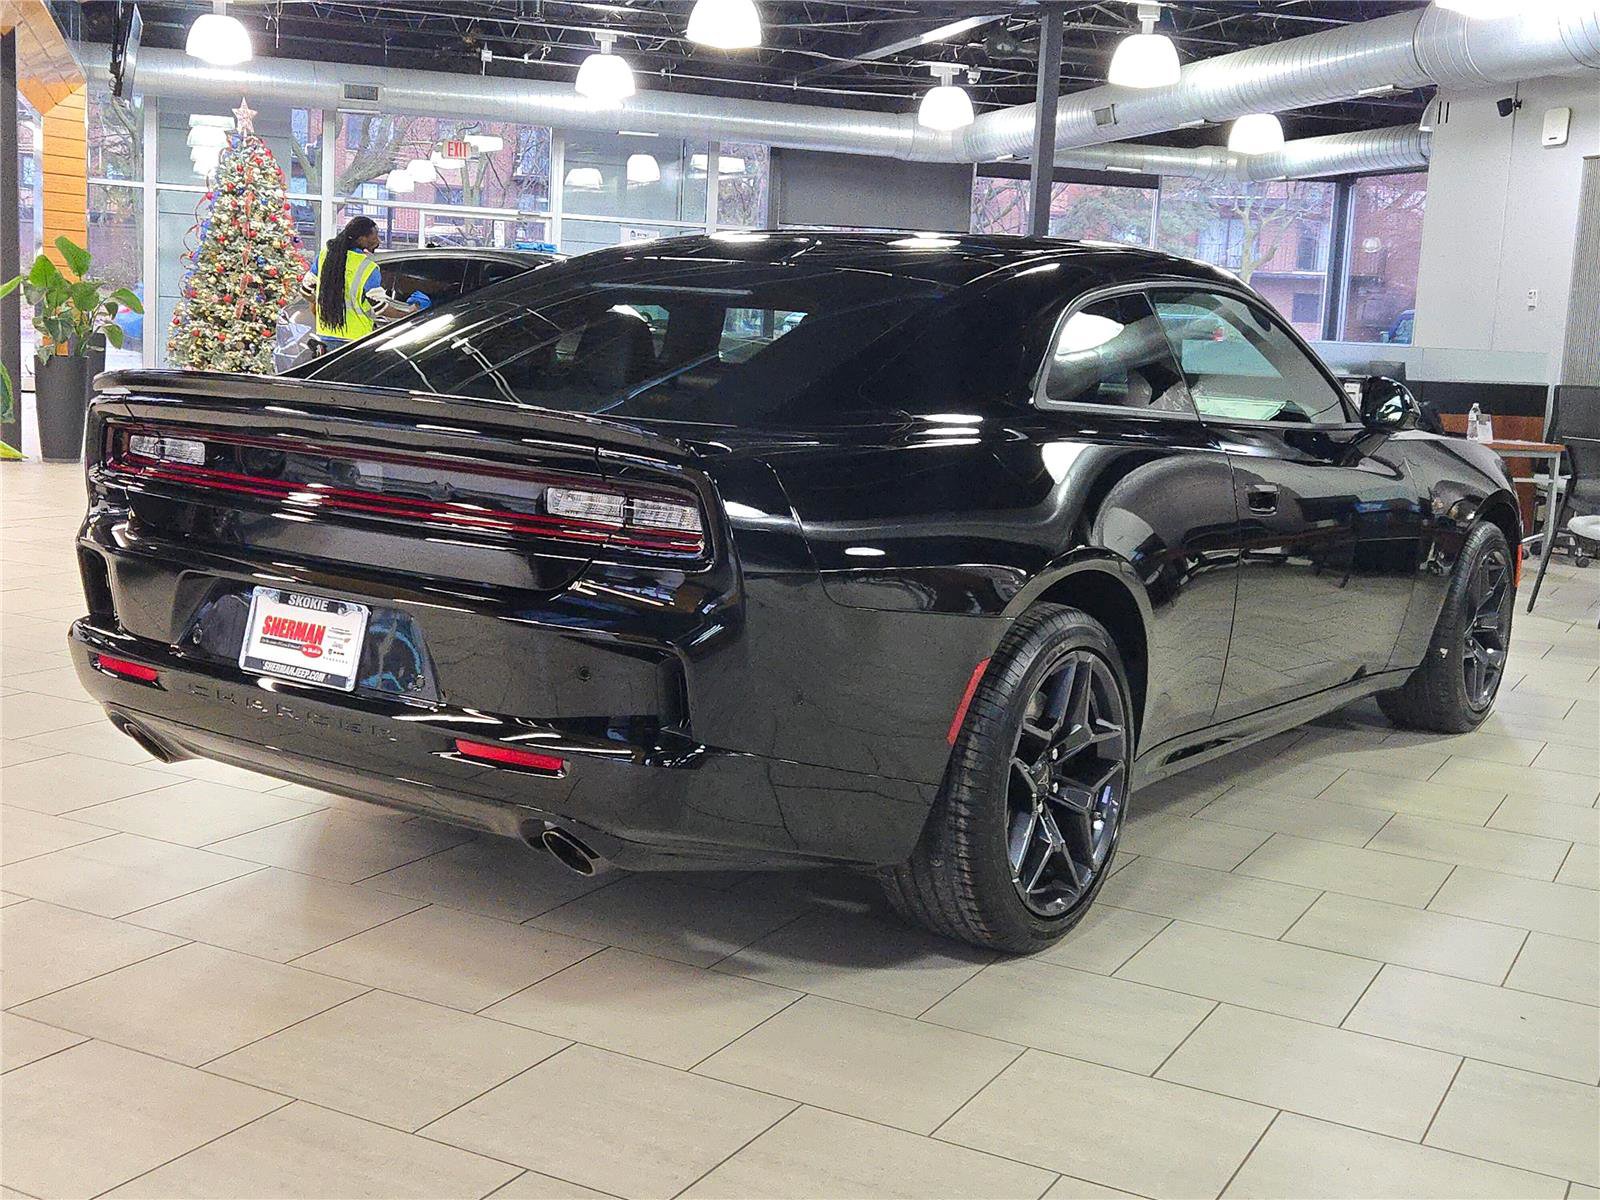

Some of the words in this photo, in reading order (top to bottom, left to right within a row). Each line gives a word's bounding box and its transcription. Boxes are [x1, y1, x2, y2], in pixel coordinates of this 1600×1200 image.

[447, 141, 467, 157] EXIT
[288, 594, 329, 611] SKOKIE
[262, 615, 326, 645] SHERMAN
[262, 661, 326, 682] SHERMANJEEP.COM
